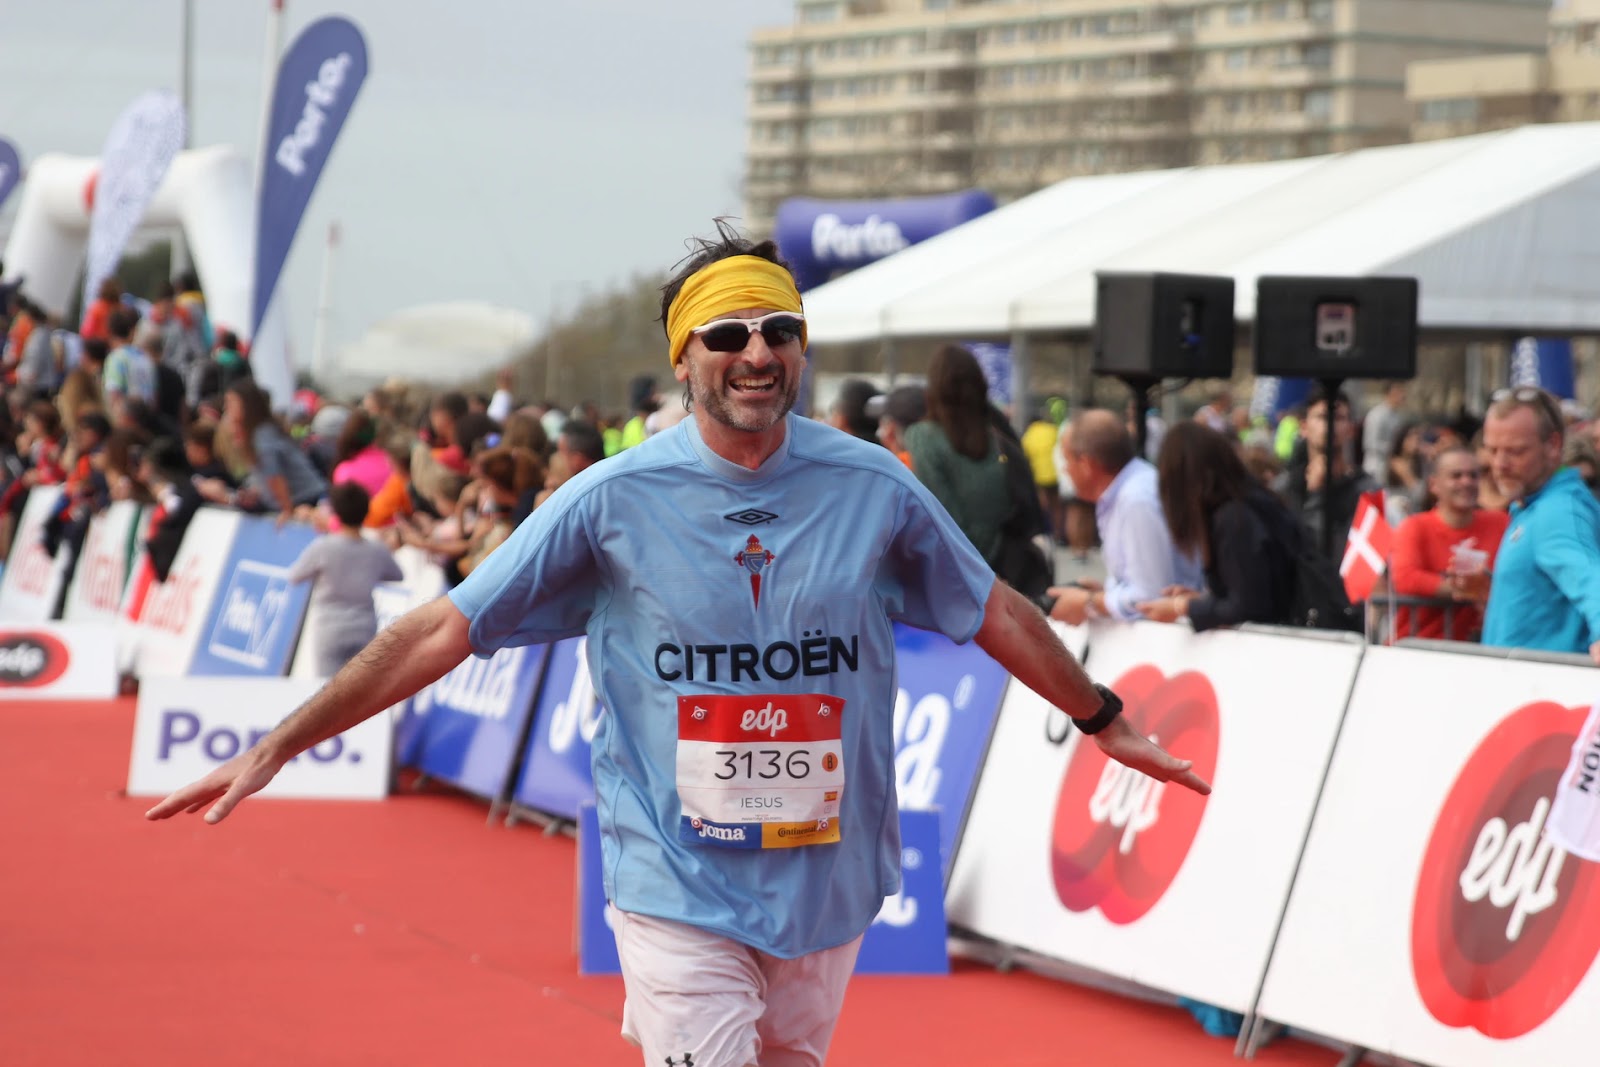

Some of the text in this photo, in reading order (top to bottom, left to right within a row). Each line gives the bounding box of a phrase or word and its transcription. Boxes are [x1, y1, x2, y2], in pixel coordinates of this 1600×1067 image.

[654, 629, 859, 682] CITROËN
[739, 701, 788, 737] edp
[714, 749, 811, 780] 3136
[740, 796, 783, 808] JESUS
[1459, 796, 1568, 942] edp
